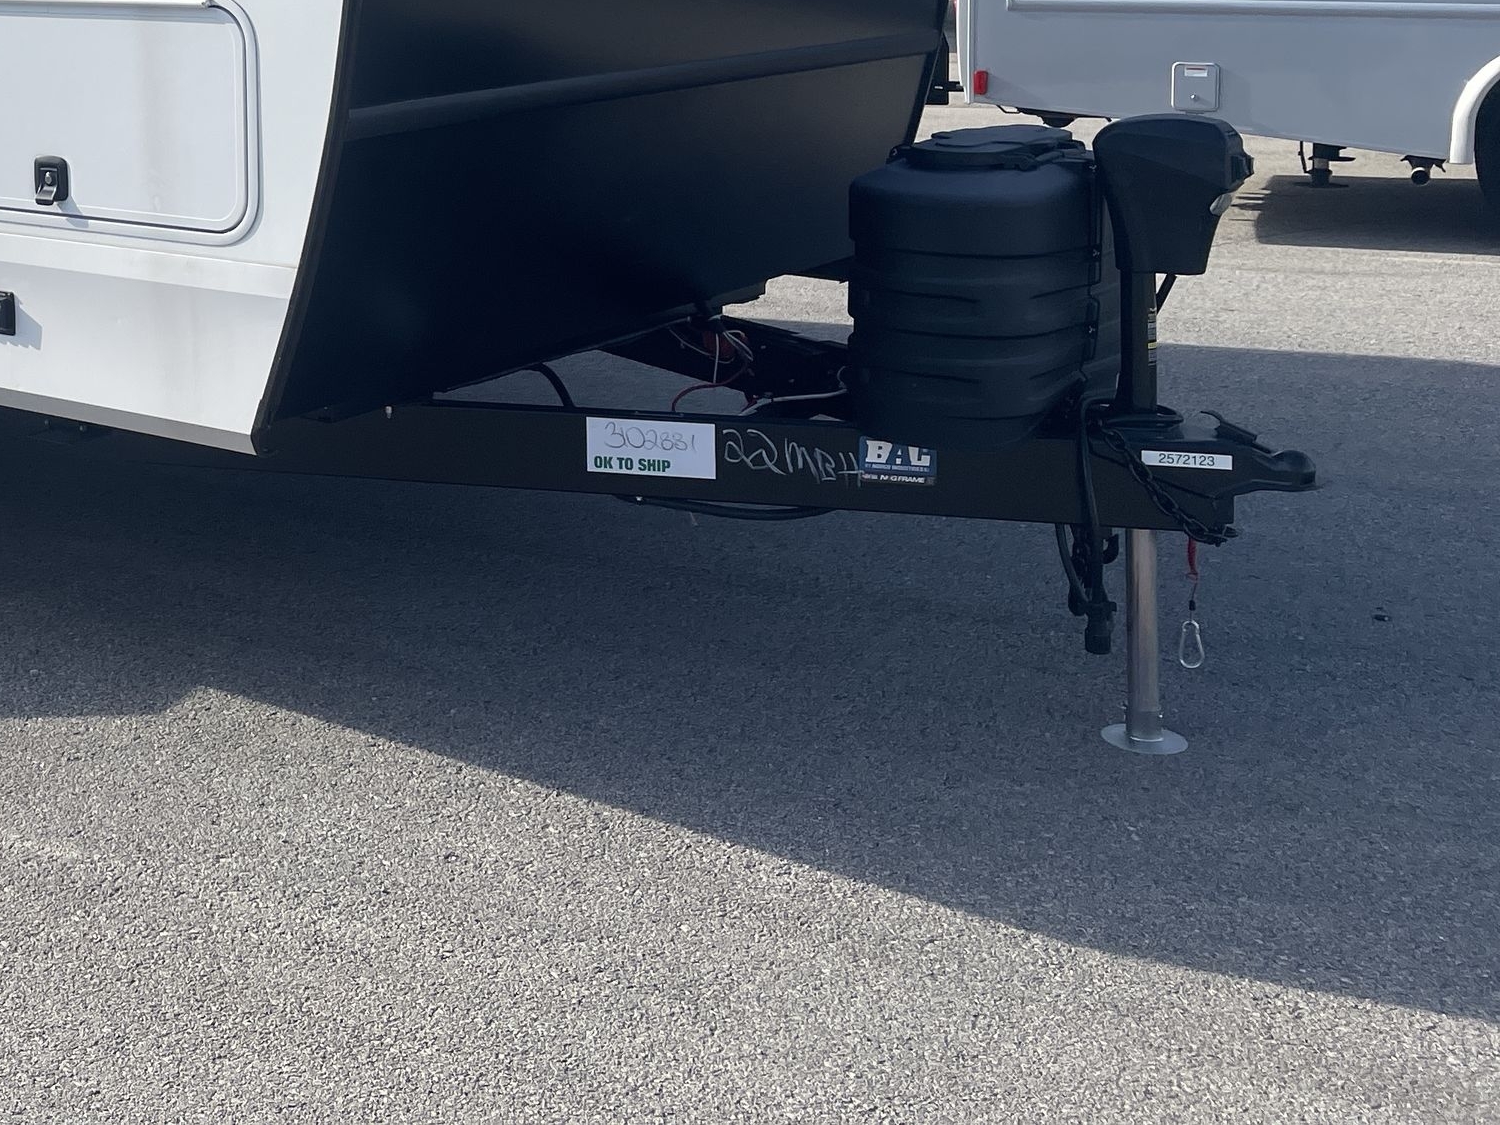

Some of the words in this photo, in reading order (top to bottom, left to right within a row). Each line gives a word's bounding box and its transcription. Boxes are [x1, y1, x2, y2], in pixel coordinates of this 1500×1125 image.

[593, 455, 614, 470] OK
[616, 456, 634, 471] TO
[637, 458, 671, 473] SHIP
[1158, 453, 1215, 467] 2572123
